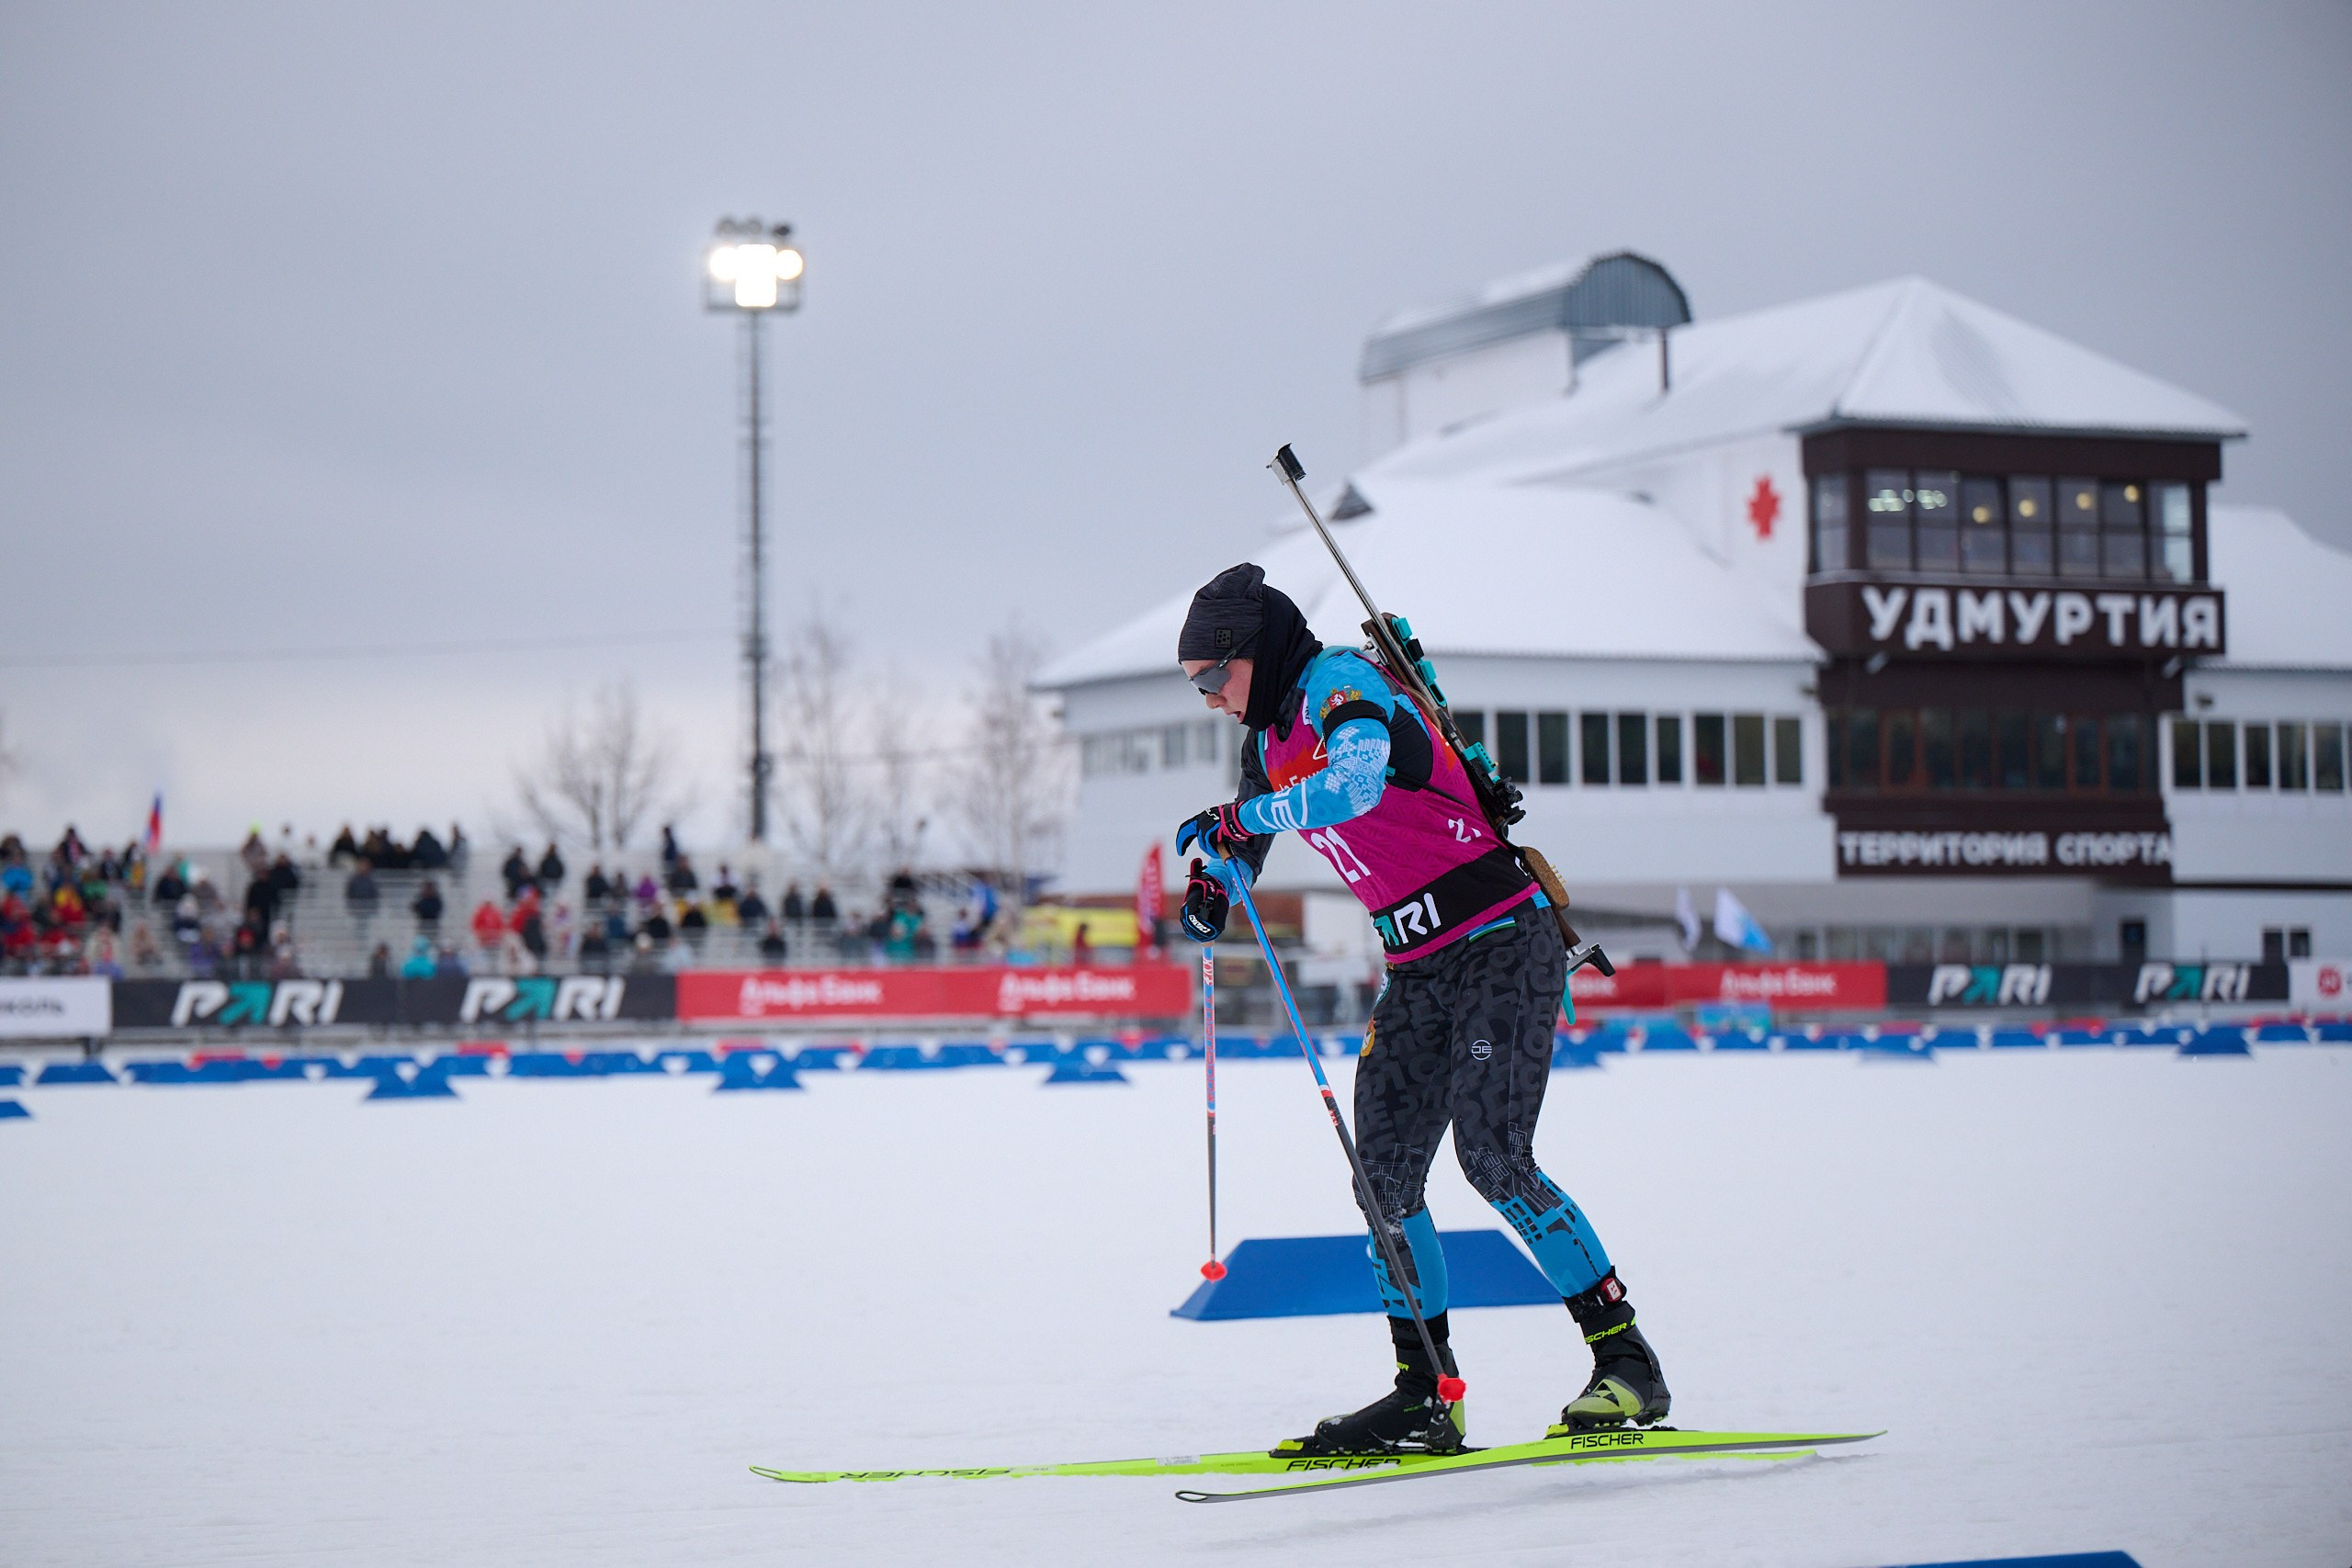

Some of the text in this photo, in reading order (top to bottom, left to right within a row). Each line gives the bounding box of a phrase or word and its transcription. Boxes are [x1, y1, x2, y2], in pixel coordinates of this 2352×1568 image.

[1861, 586, 2221, 650] УДМУРТИЯ
[1311, 827, 1371, 883] 21
[1839, 832, 2171, 866] ТЕРРИТОРИЯ СПОРТА
[171, 979, 344, 1027] PARI
[460, 976, 625, 1024] PARI
[1928, 963, 2052, 1006] PARI
[2134, 963, 2251, 1004] PARI
[1571, 1433, 1644, 1450] FISCHER
